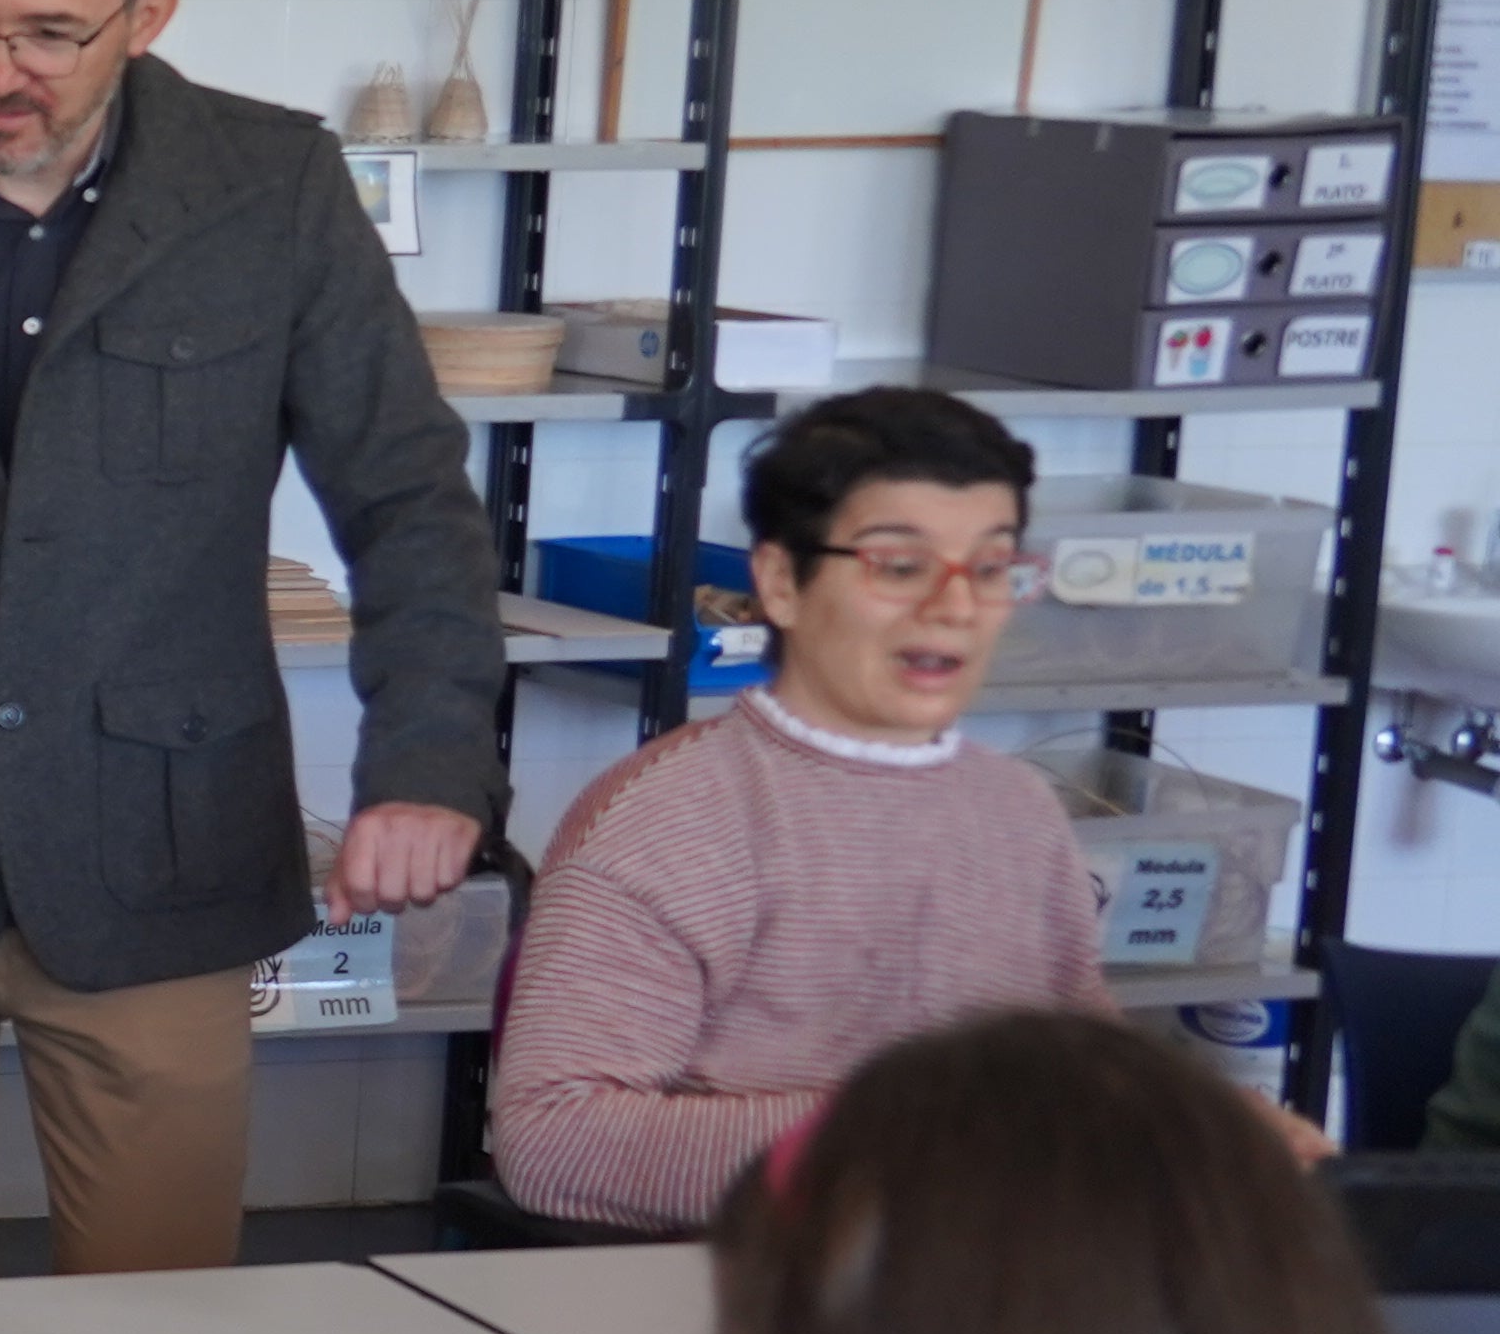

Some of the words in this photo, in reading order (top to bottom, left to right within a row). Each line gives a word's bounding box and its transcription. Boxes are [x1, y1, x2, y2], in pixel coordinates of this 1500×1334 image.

[1286, 330, 1360, 347] POSTRE
[1142, 888, 1185, 911] 2,5
[1128, 929, 1177, 945] mm
[333, 951, 349, 974] 2
[319, 996, 371, 1016] mm
